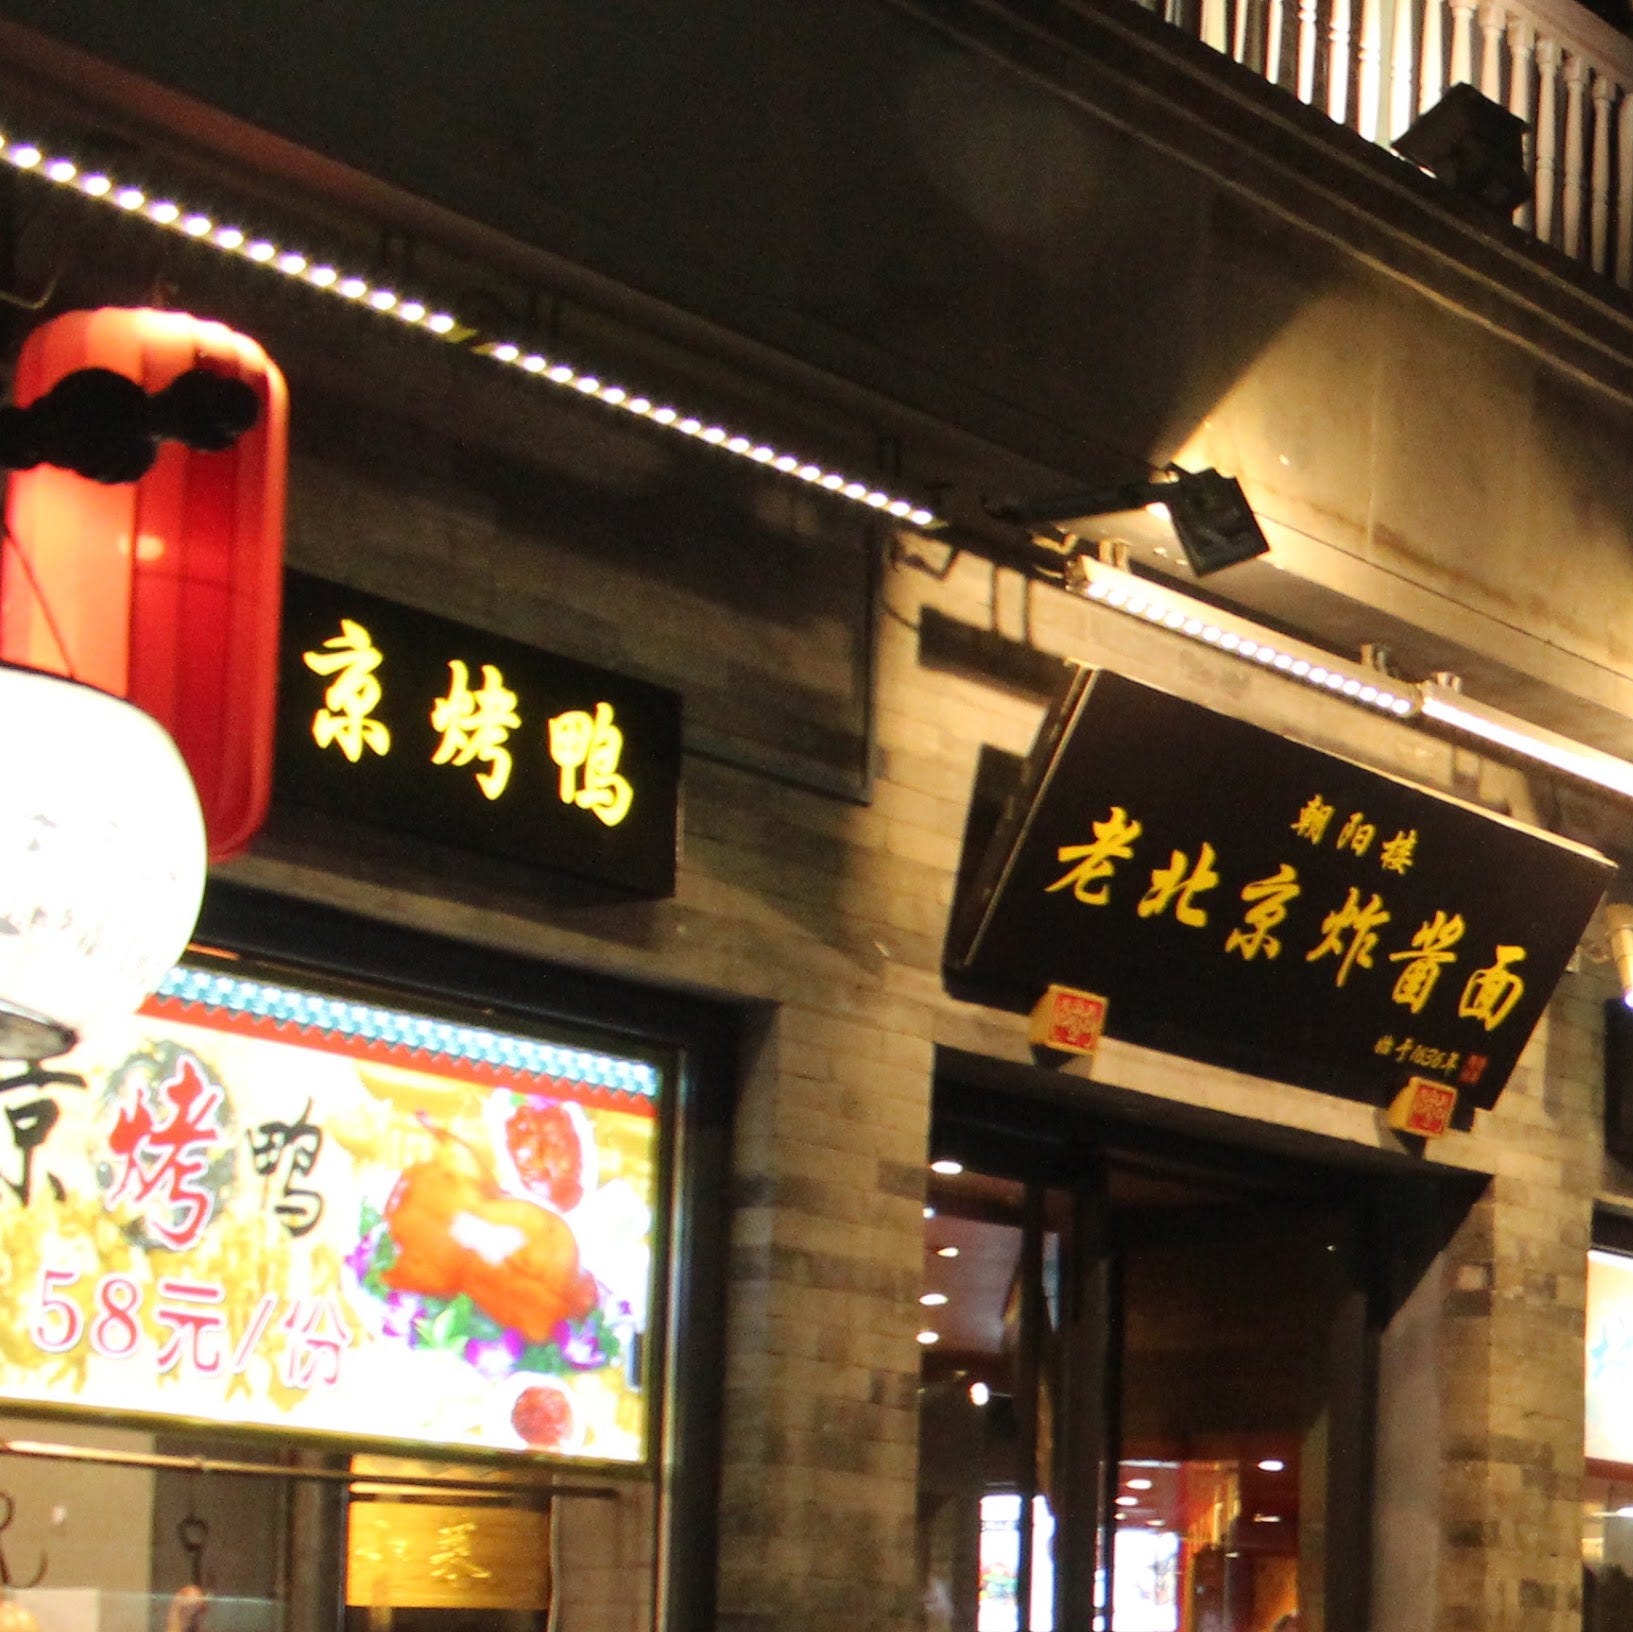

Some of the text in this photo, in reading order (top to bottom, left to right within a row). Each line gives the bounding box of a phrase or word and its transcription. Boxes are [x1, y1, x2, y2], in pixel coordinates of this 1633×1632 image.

[303, 617, 635, 828] 京烤鸭
[1290, 793, 1419, 876] 朝阳楼
[1044, 806, 1527, 1031] 老北京炸酱面
[33, 1268, 350, 1388] 58元/份
